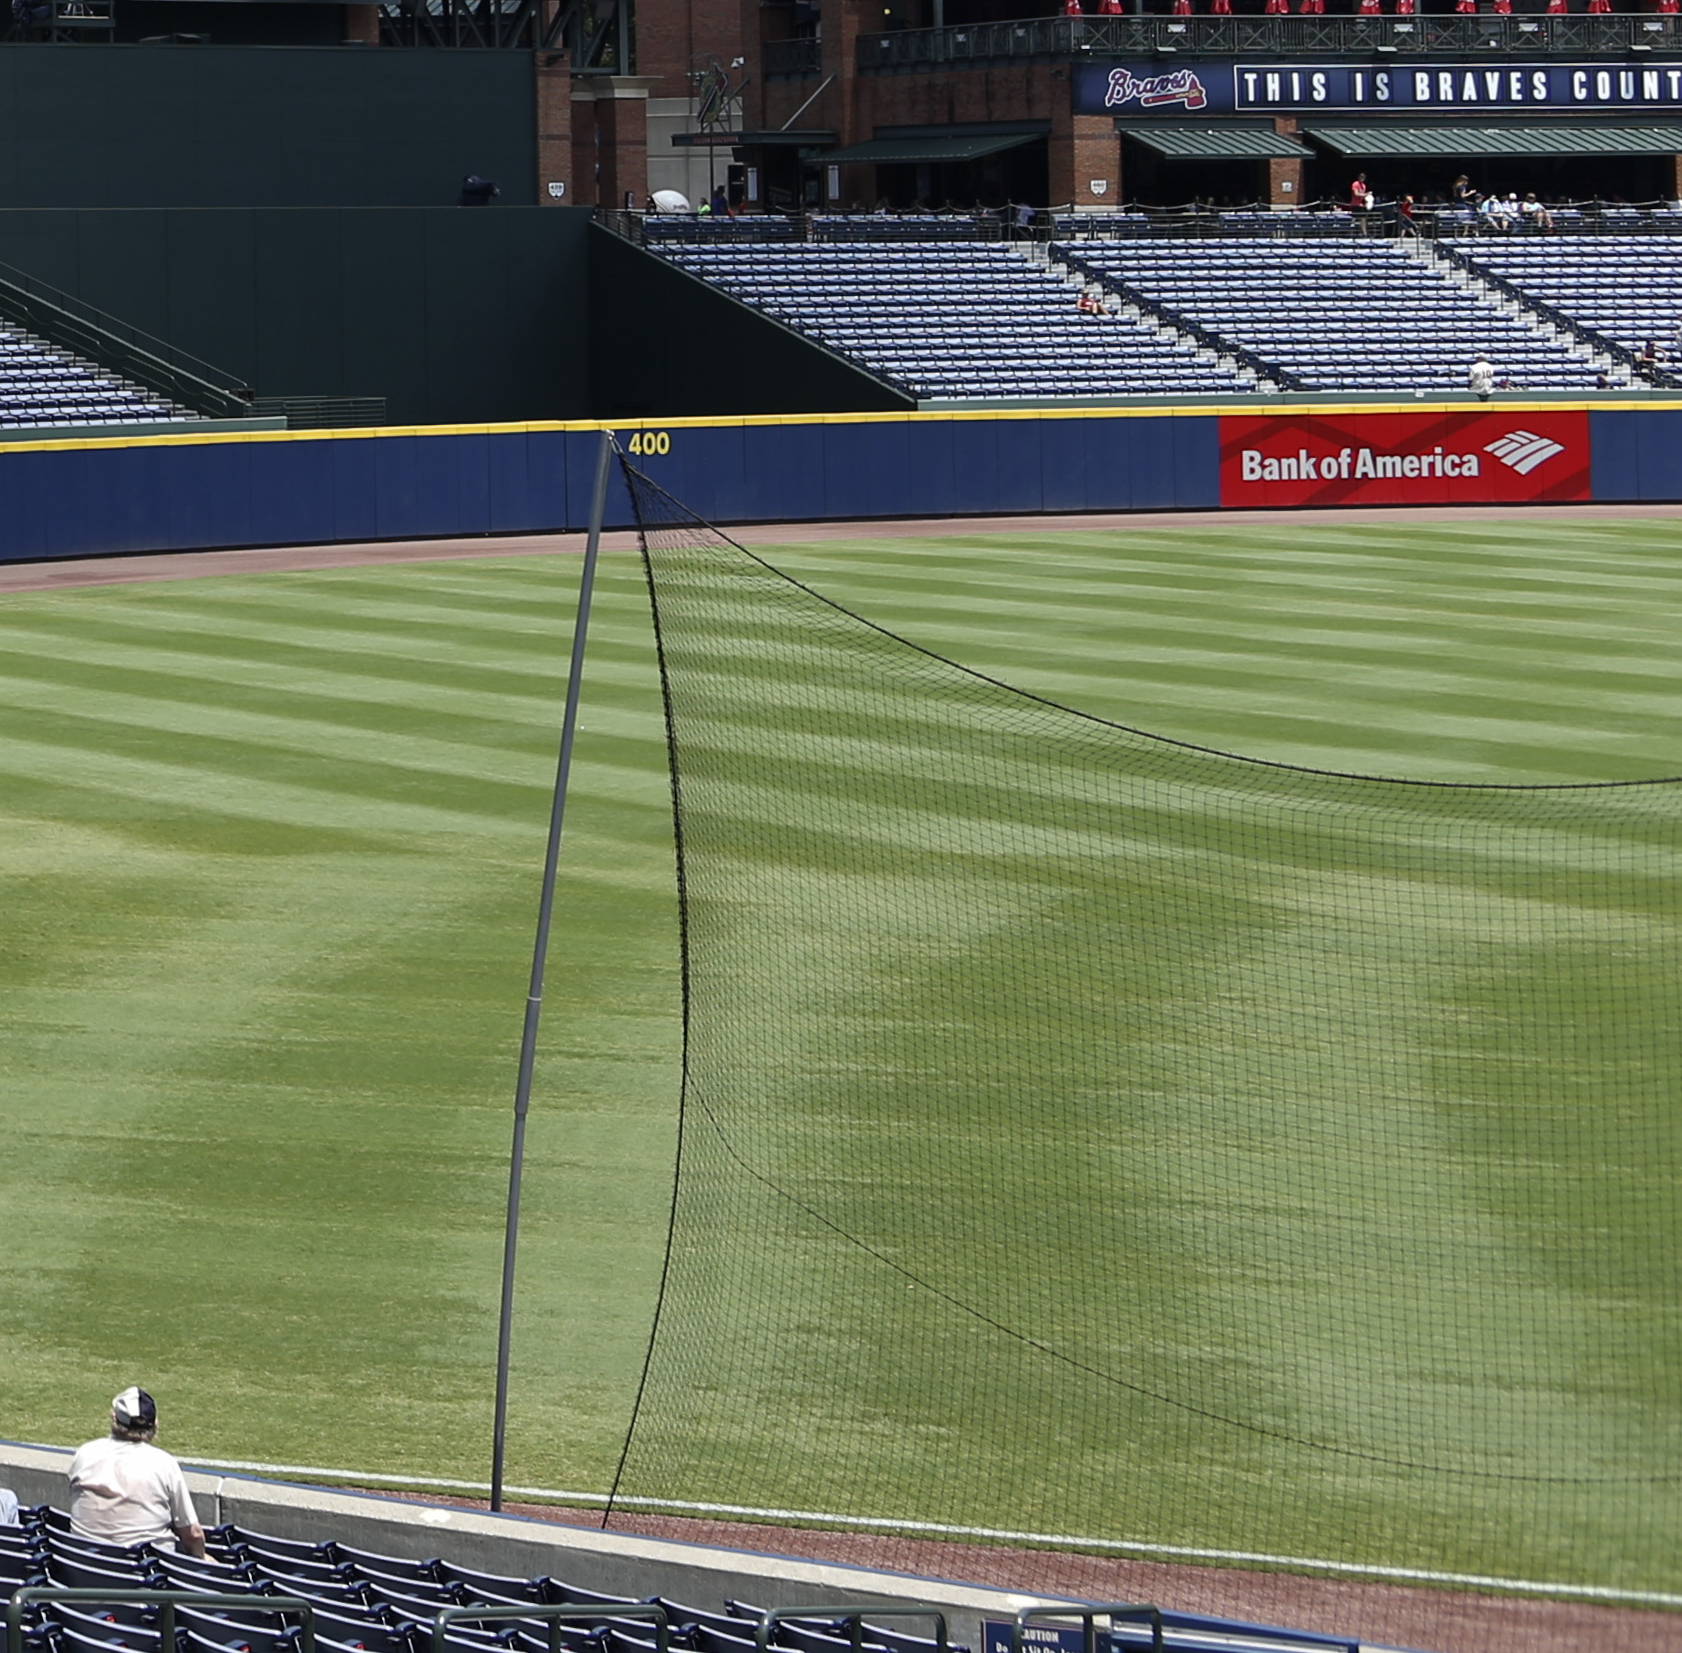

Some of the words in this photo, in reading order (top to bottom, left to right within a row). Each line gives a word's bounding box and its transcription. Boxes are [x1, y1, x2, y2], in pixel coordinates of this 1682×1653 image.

[1244, 72, 1326, 102] THIS
[1355, 72, 1390, 101] IS
[1415, 71, 1547, 101] BRAVES
[1573, 71, 1682, 100] COUNT
[628, 431, 670, 456] 400
[1241, 449, 1318, 481] Bank
[1320, 447, 1352, 479] of
[1354, 446, 1479, 479] America
